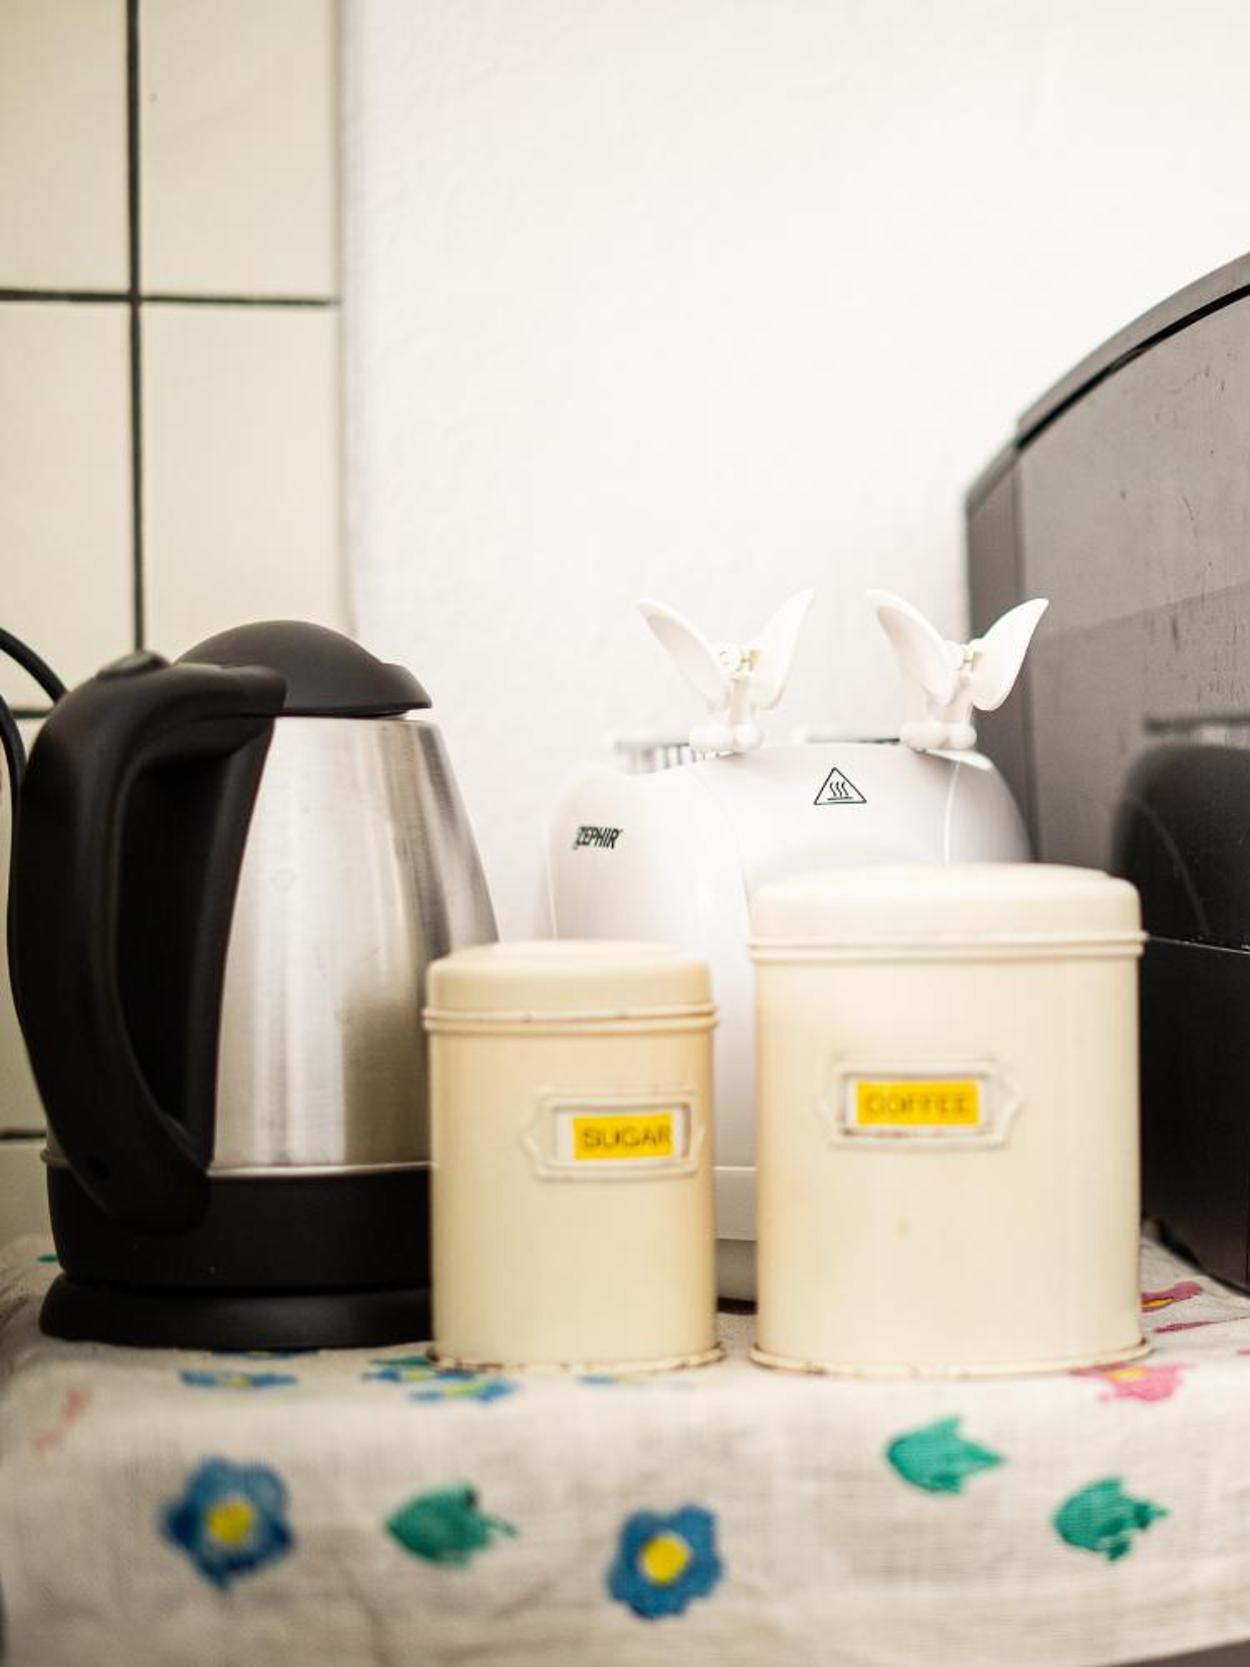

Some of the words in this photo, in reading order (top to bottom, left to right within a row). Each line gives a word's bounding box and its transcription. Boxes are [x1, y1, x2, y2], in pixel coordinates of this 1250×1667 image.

[573, 826, 623, 850] ZEPHIR
[863, 1091, 968, 1115] COFFEE
[581, 1123, 671, 1149] SUGAR
